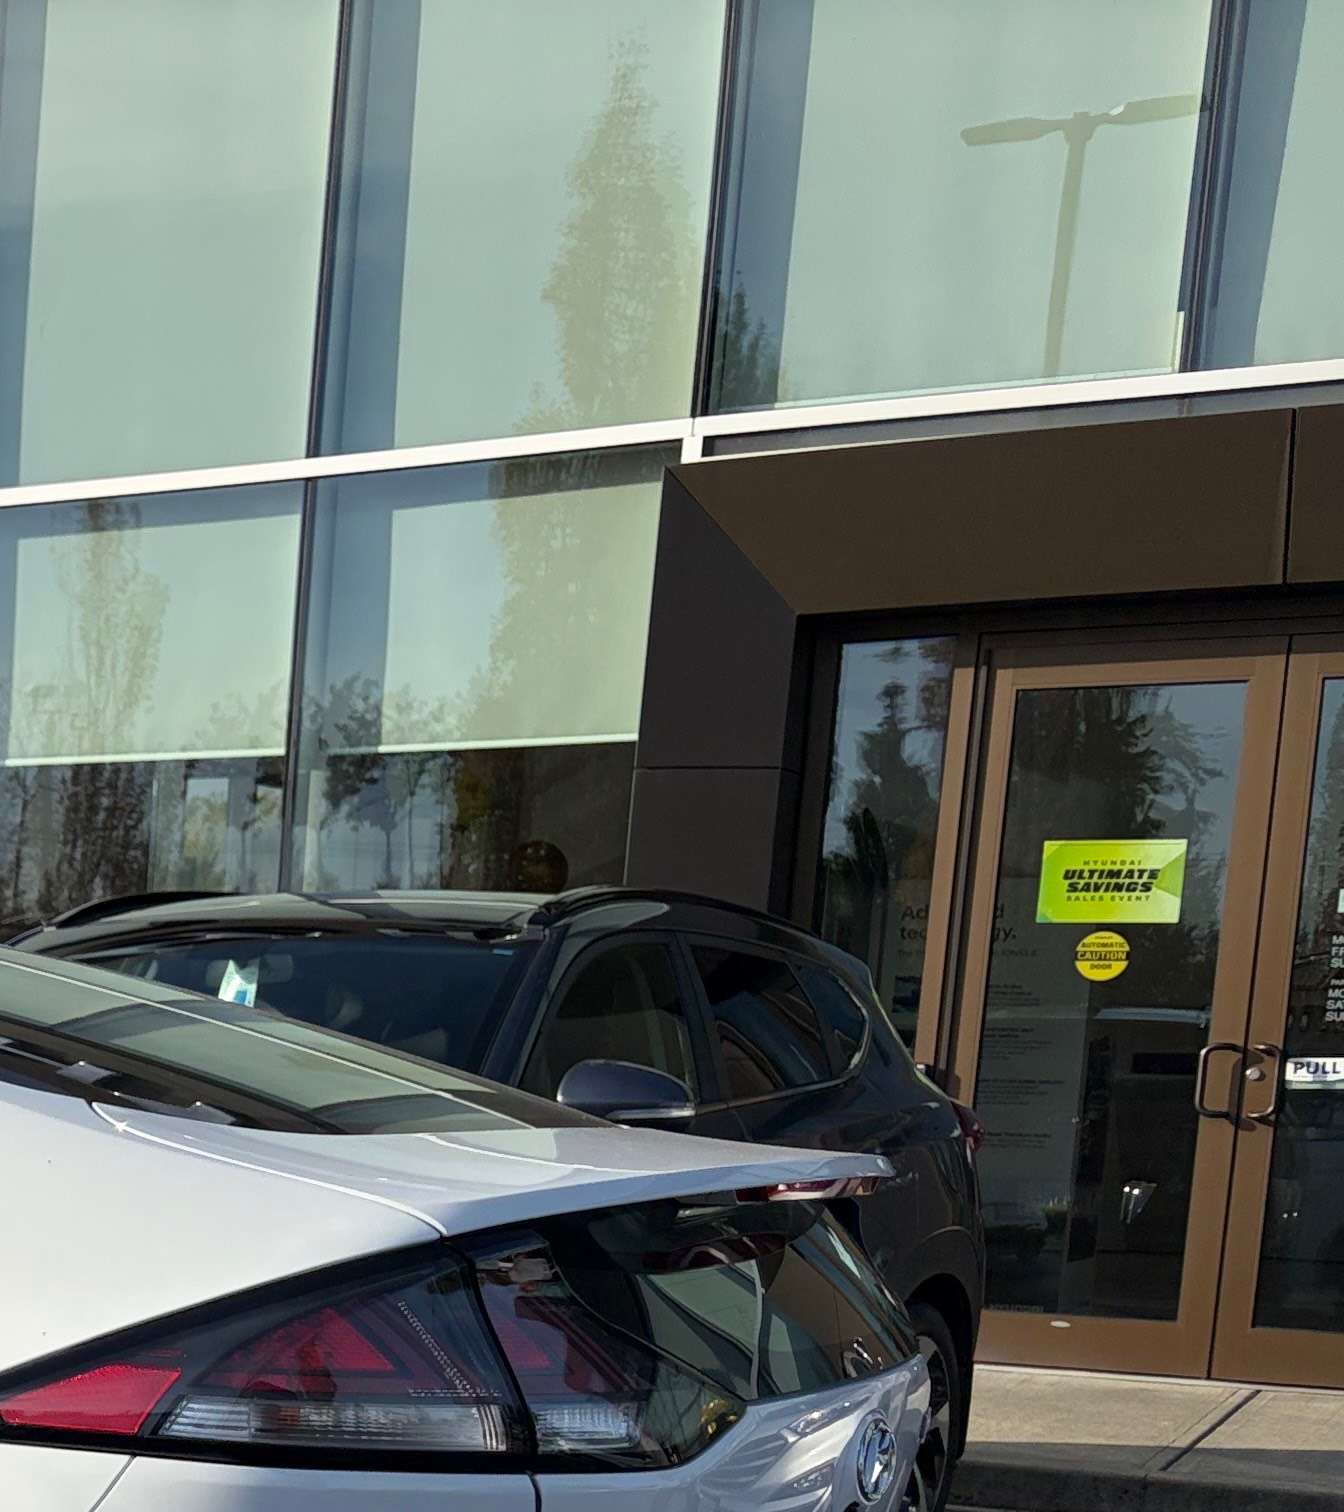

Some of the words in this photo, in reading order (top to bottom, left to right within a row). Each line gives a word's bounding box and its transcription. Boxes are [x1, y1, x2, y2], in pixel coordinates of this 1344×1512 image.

[1063, 869, 1161, 880] ULTIMATE
[1066, 881, 1154, 893] SAVINGS
[1081, 941, 1126, 949] AUTOMATIC
[1077, 951, 1127, 960] CAUTION
[1293, 1061, 1340, 1075] PULL
